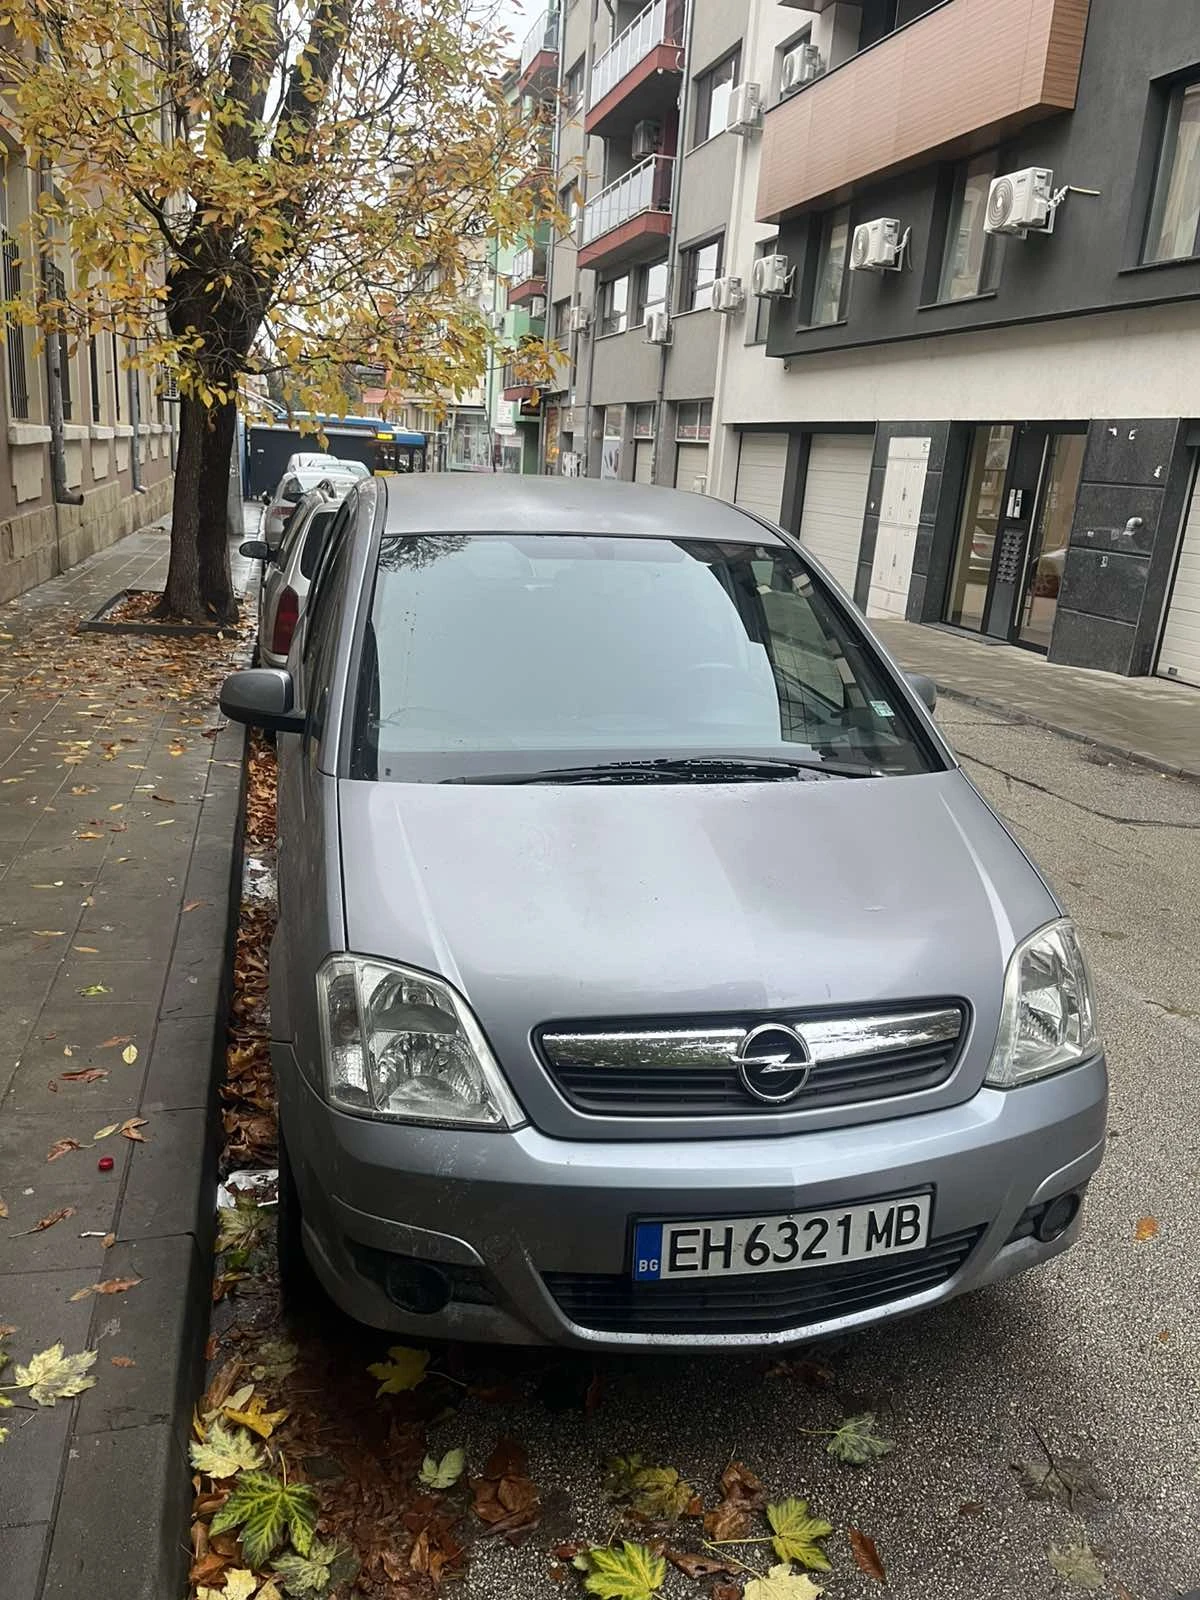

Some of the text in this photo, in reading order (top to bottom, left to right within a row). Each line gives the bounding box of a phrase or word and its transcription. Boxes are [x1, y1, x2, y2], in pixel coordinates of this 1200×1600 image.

[669, 1203, 922, 1273] EH 6321 MB
[637, 1258, 659, 1273] BG
